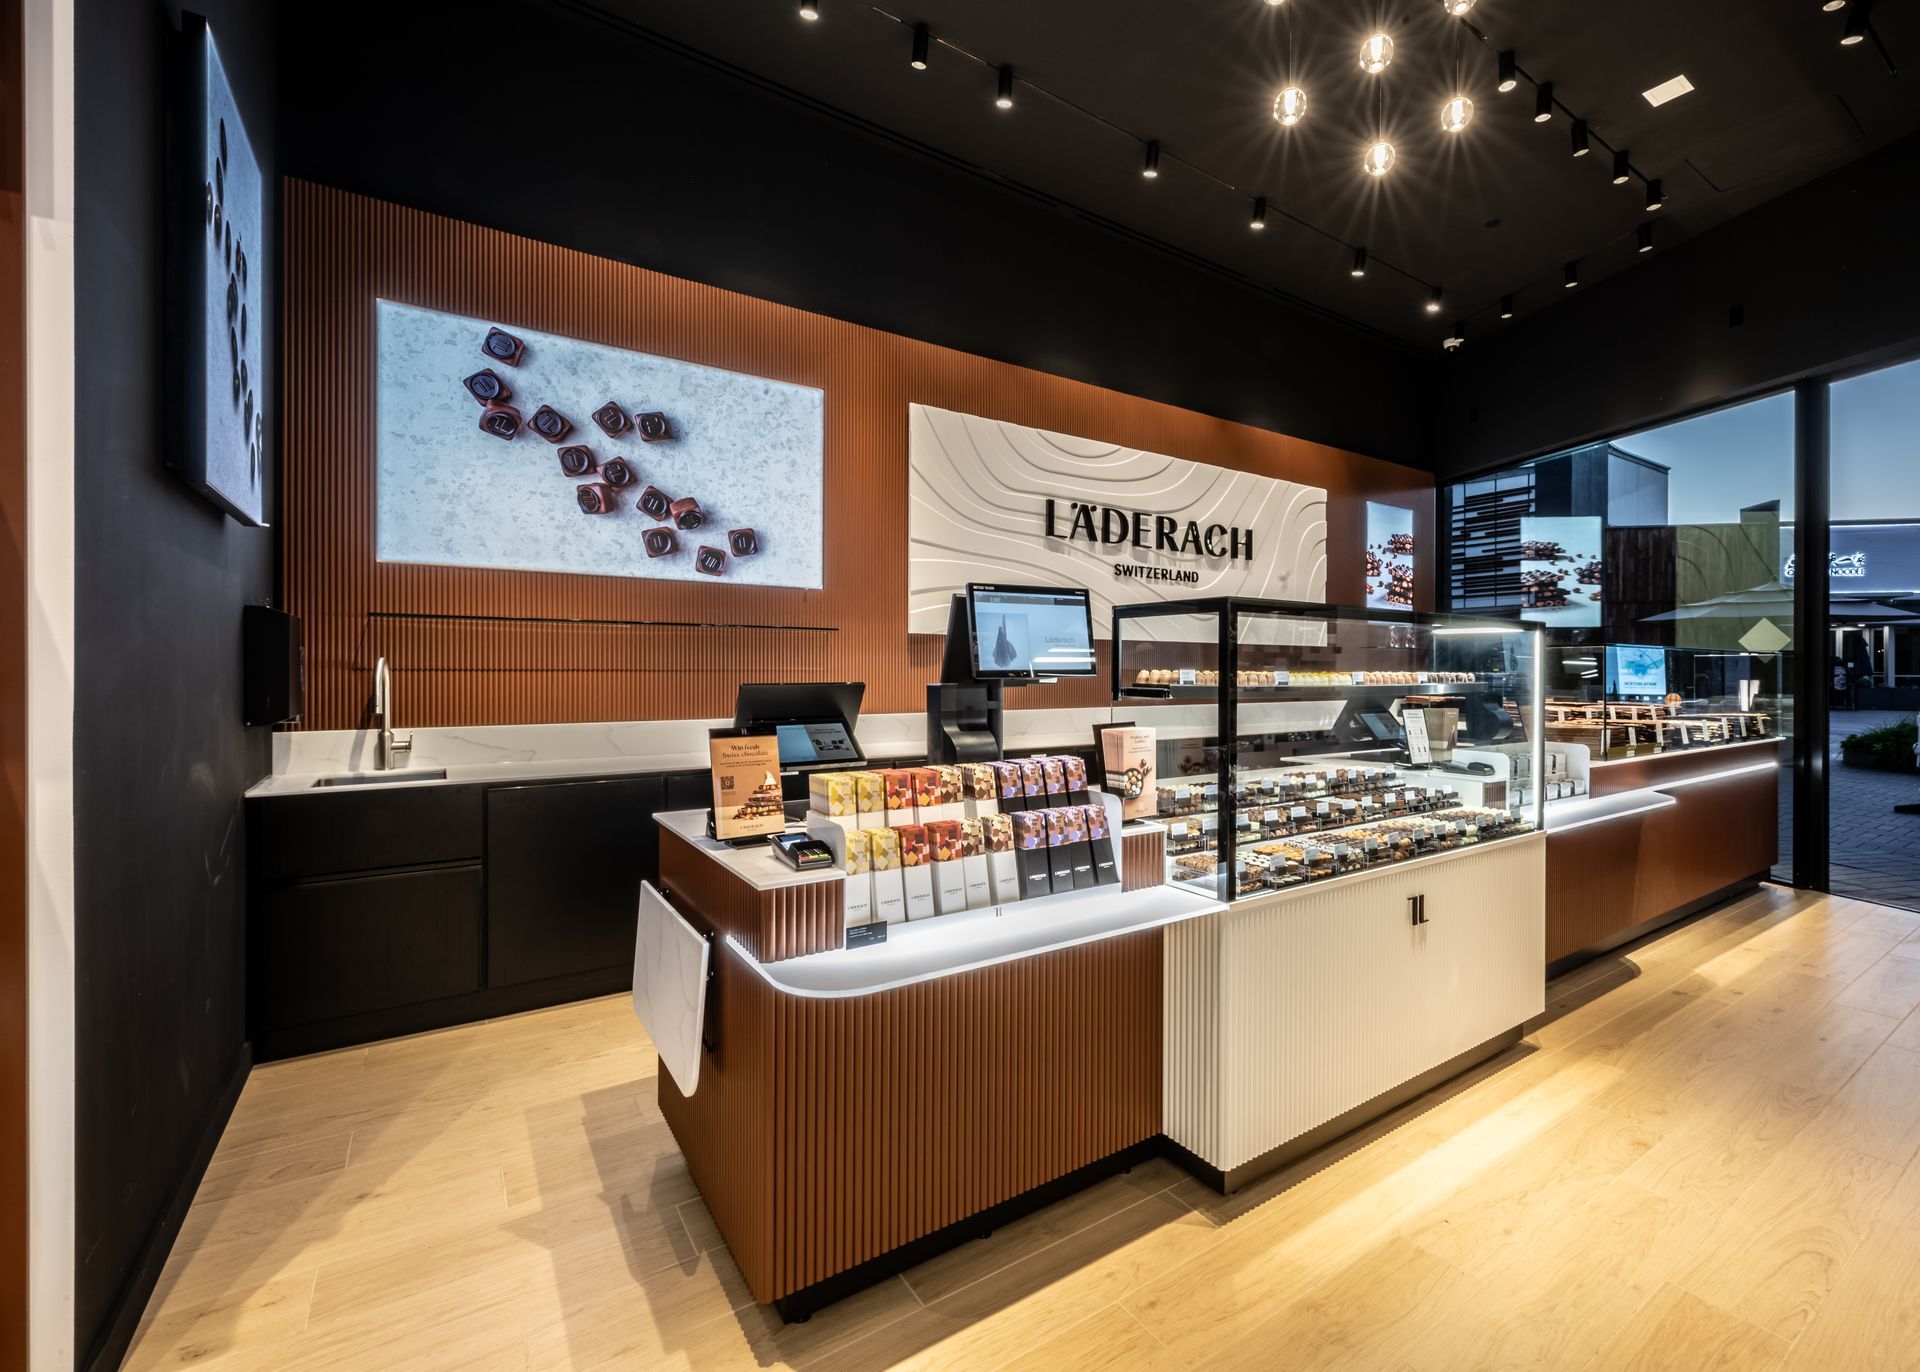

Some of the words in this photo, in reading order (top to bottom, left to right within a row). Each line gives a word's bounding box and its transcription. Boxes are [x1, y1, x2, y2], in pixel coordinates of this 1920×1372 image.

[1045, 498, 1253, 561] LÄDERACH
[1114, 563, 1199, 583] SWITZERLAND
[1830, 567, 1865, 577] NOODLE
[744, 743, 760, 751] fresh
